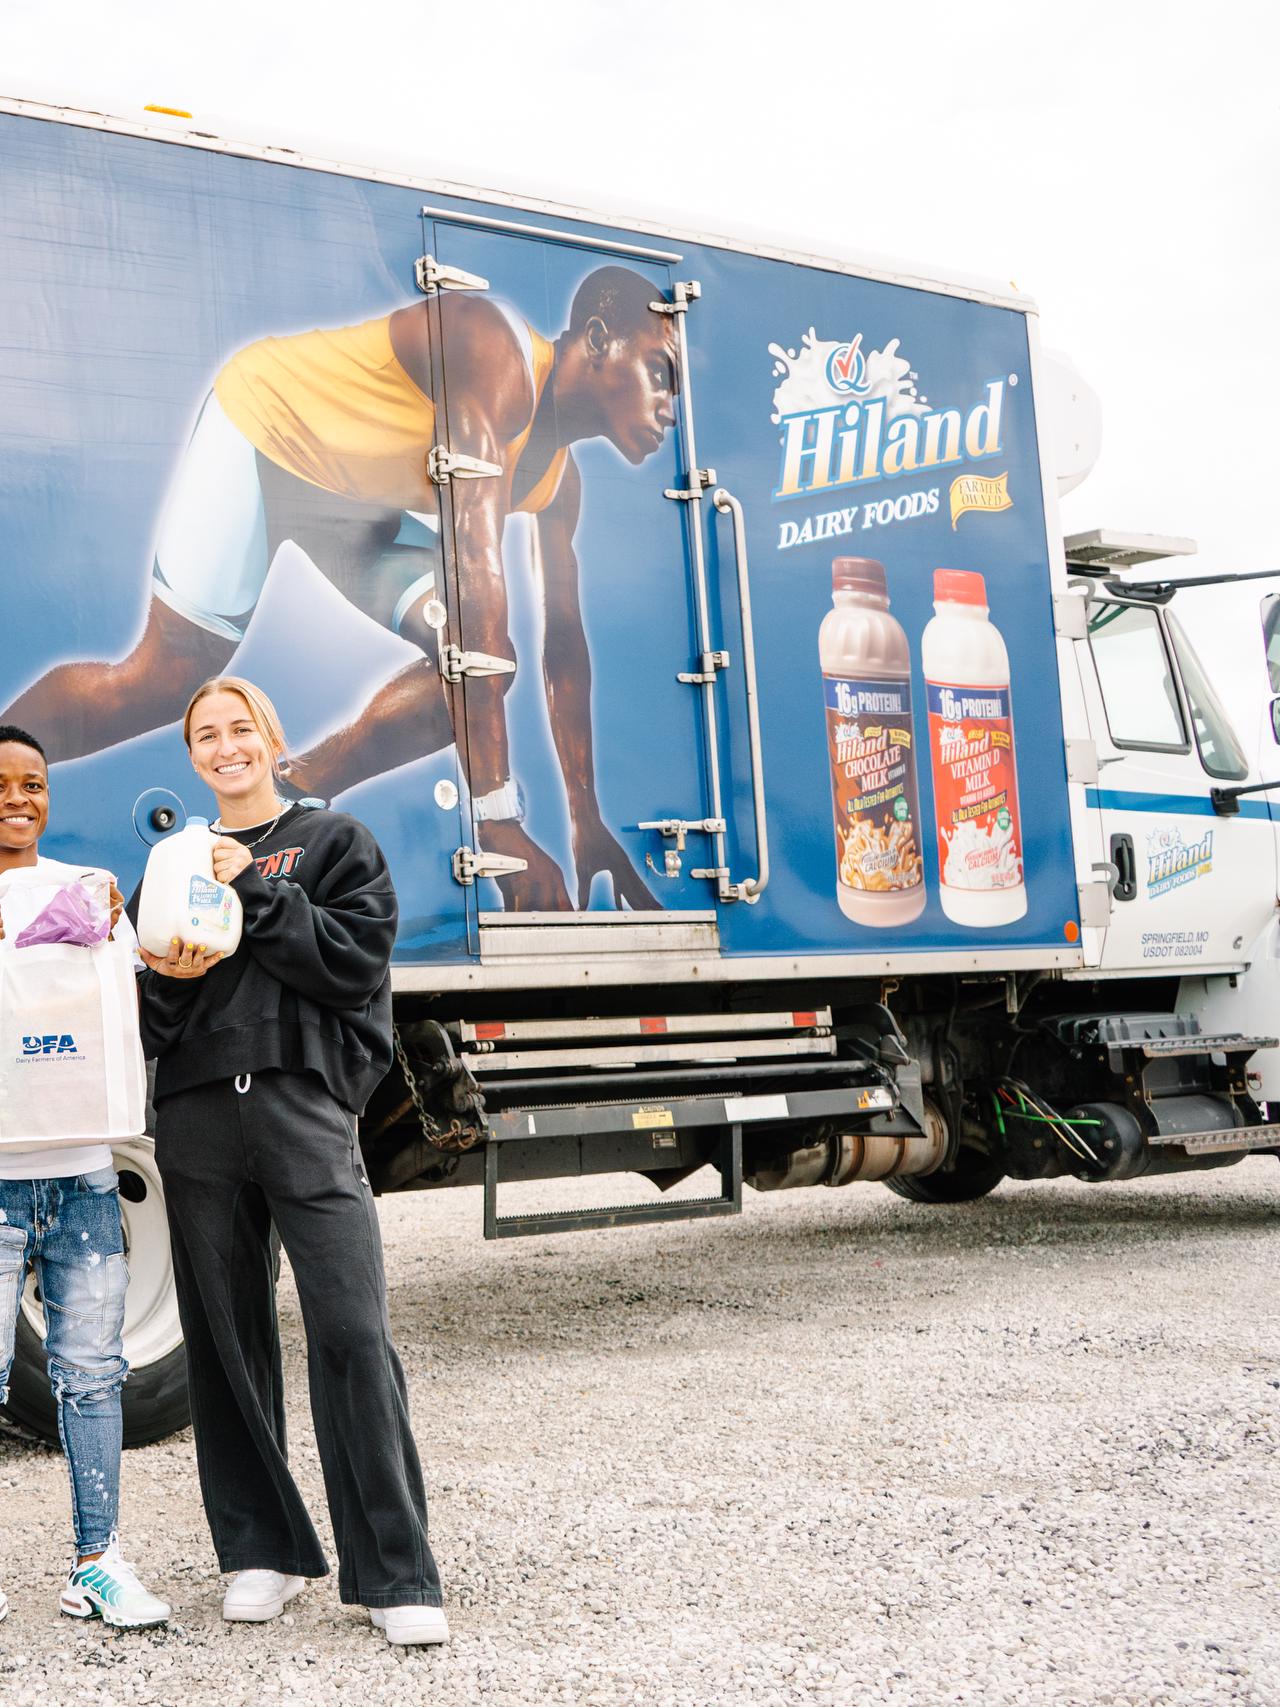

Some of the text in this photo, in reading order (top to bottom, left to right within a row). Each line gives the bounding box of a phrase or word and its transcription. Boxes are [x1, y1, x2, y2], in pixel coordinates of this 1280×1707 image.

[773, 378, 1006, 500] Hiland
[959, 480, 1002, 494] FARMER
[961, 494, 1003, 506] OWNED
[777, 488, 940, 549] DAIRY FOODS
[836, 728, 888, 764] Hiland
[941, 731, 989, 765] Hiland
[845, 745, 902, 778] CHOCOLATE
[950, 747, 1001, 779] VITAMIN D
[862, 768, 889, 792] MILK
[965, 771, 991, 793] MILK
[1147, 830, 1213, 887] Hiland
[1196, 931, 1209, 942] MO
[1143, 945, 1203, 957] USDOT 082004
[23, 1035, 77, 1054] DFA
